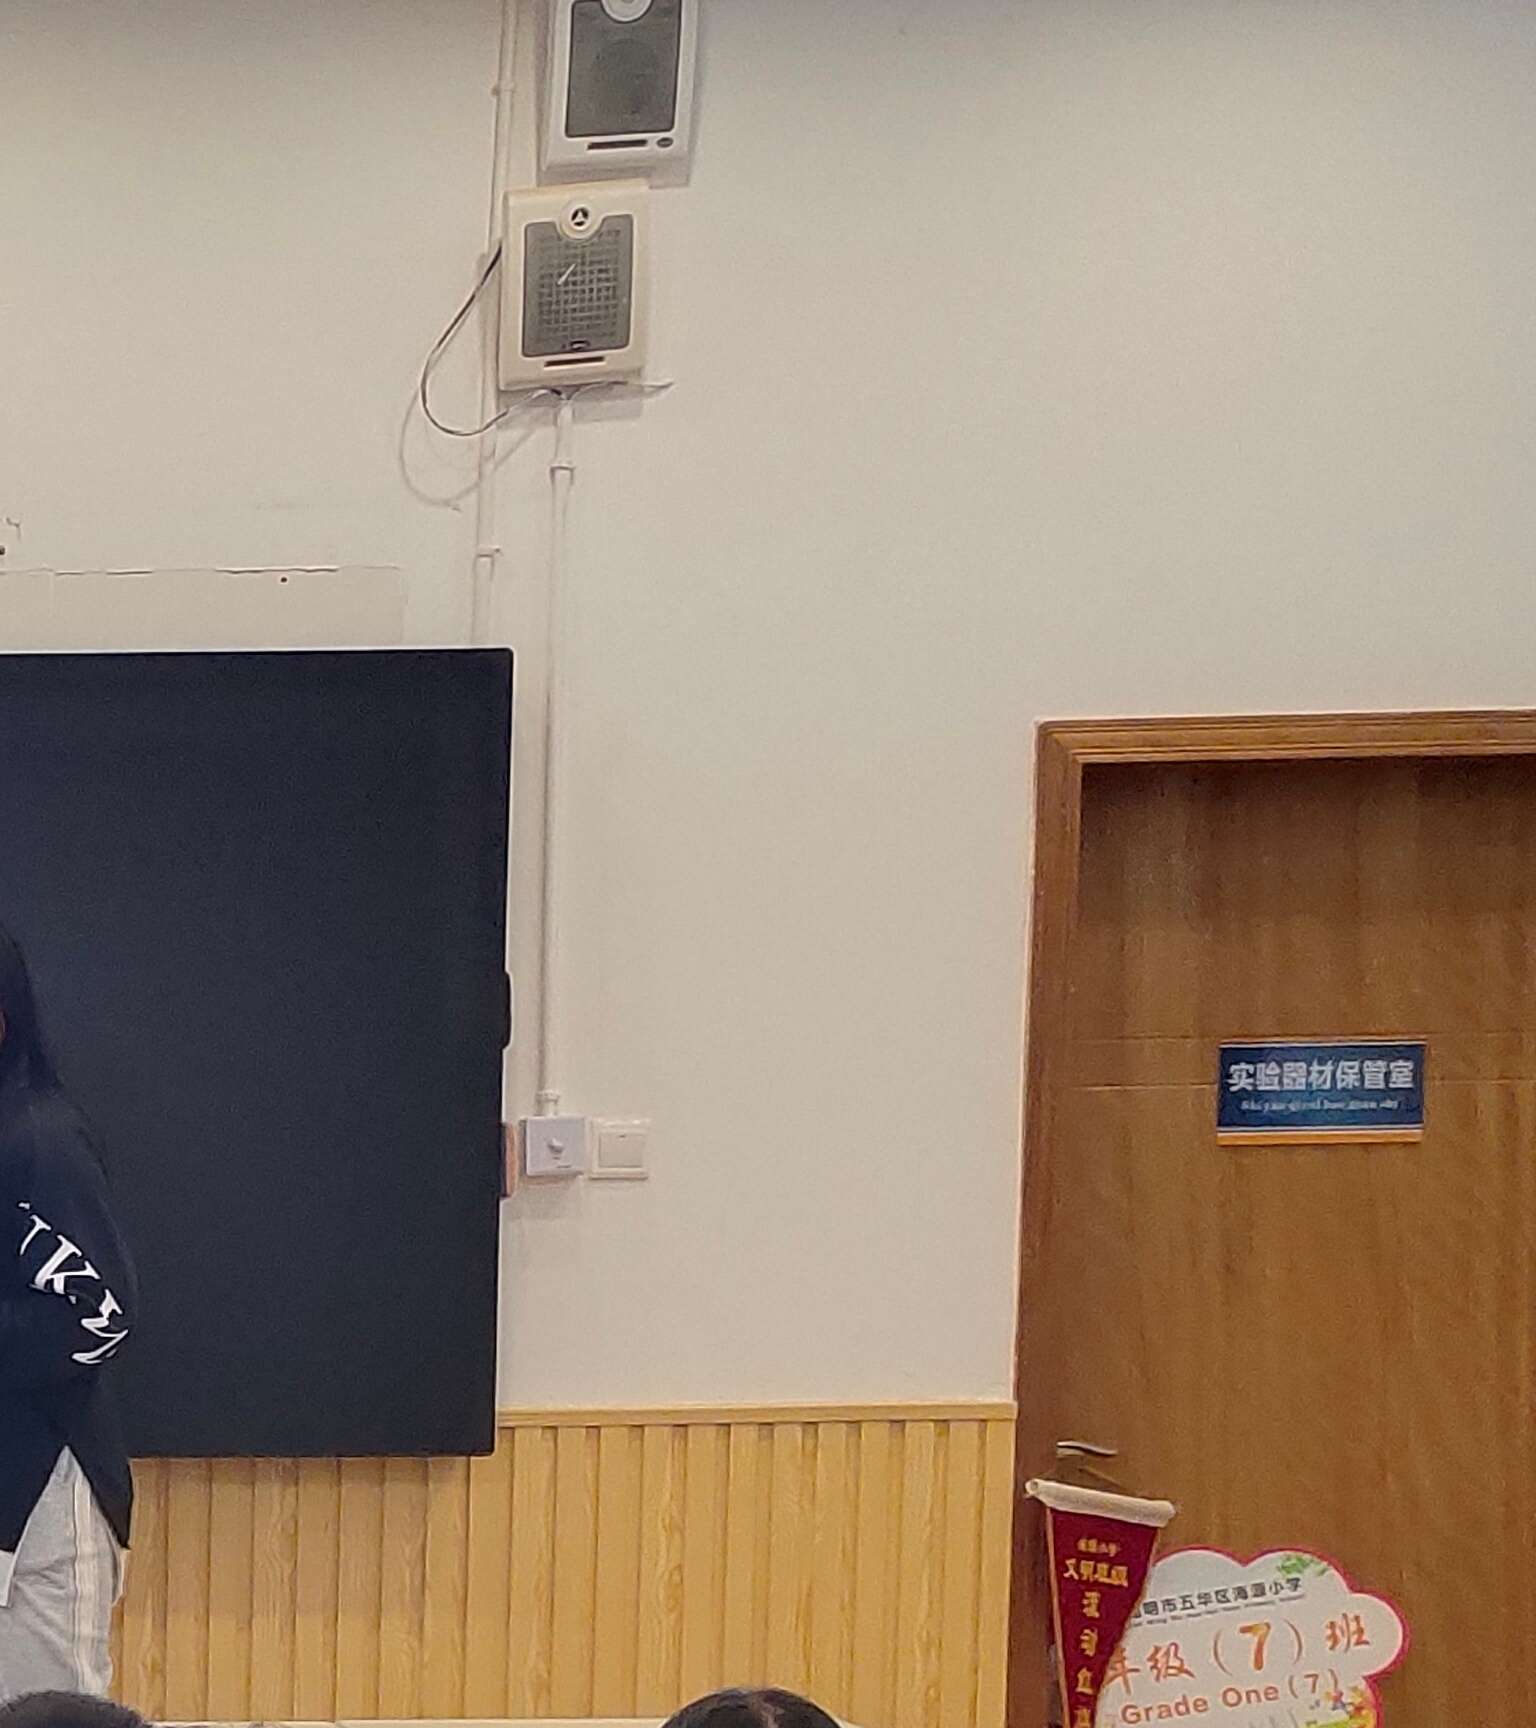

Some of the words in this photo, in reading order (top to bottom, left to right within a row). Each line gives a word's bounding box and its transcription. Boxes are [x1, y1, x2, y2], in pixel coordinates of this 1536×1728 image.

[1227, 1058, 1414, 1092] 实验器材保管室
[1132, 1577, 1301, 1618] 明市五华区海源小学
[1121, 1693, 1210, 1725] Grade
[1221, 1684, 1280, 1708] One
